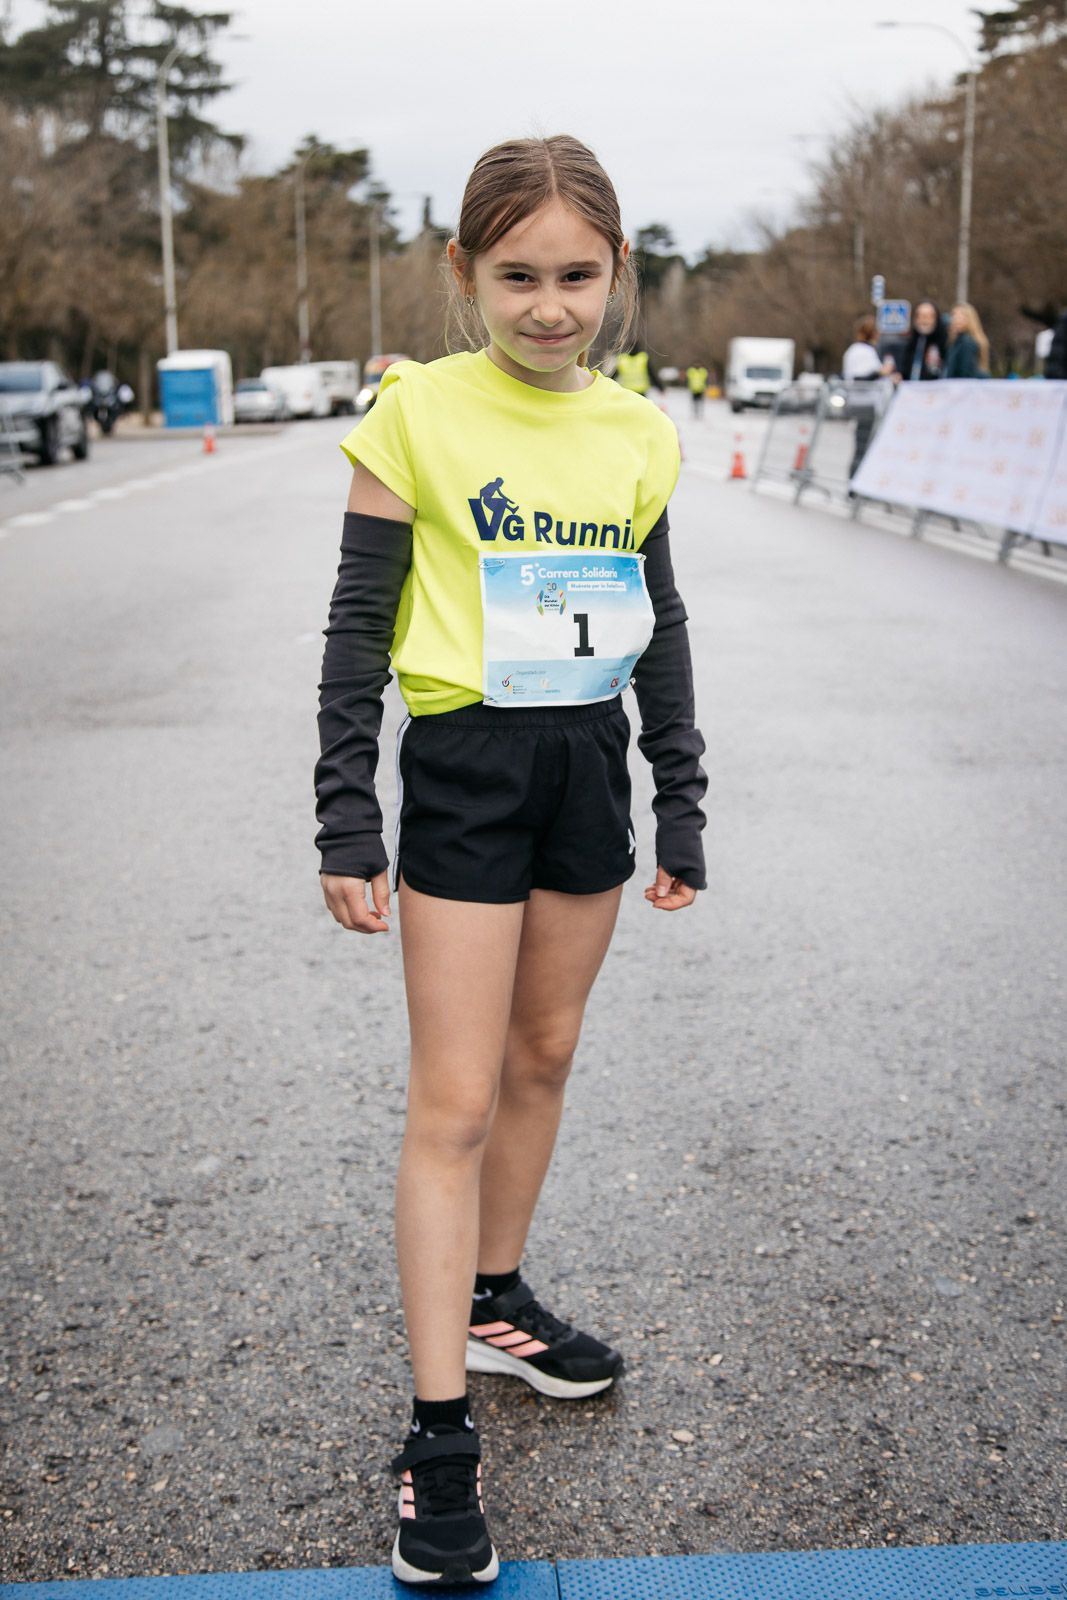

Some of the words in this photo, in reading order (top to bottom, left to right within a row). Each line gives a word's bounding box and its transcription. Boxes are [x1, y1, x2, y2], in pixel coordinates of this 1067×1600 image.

[533, 511, 635, 550] Runni
[538, 568, 580, 578] Carrera
[573, 613, 595, 658] 1
